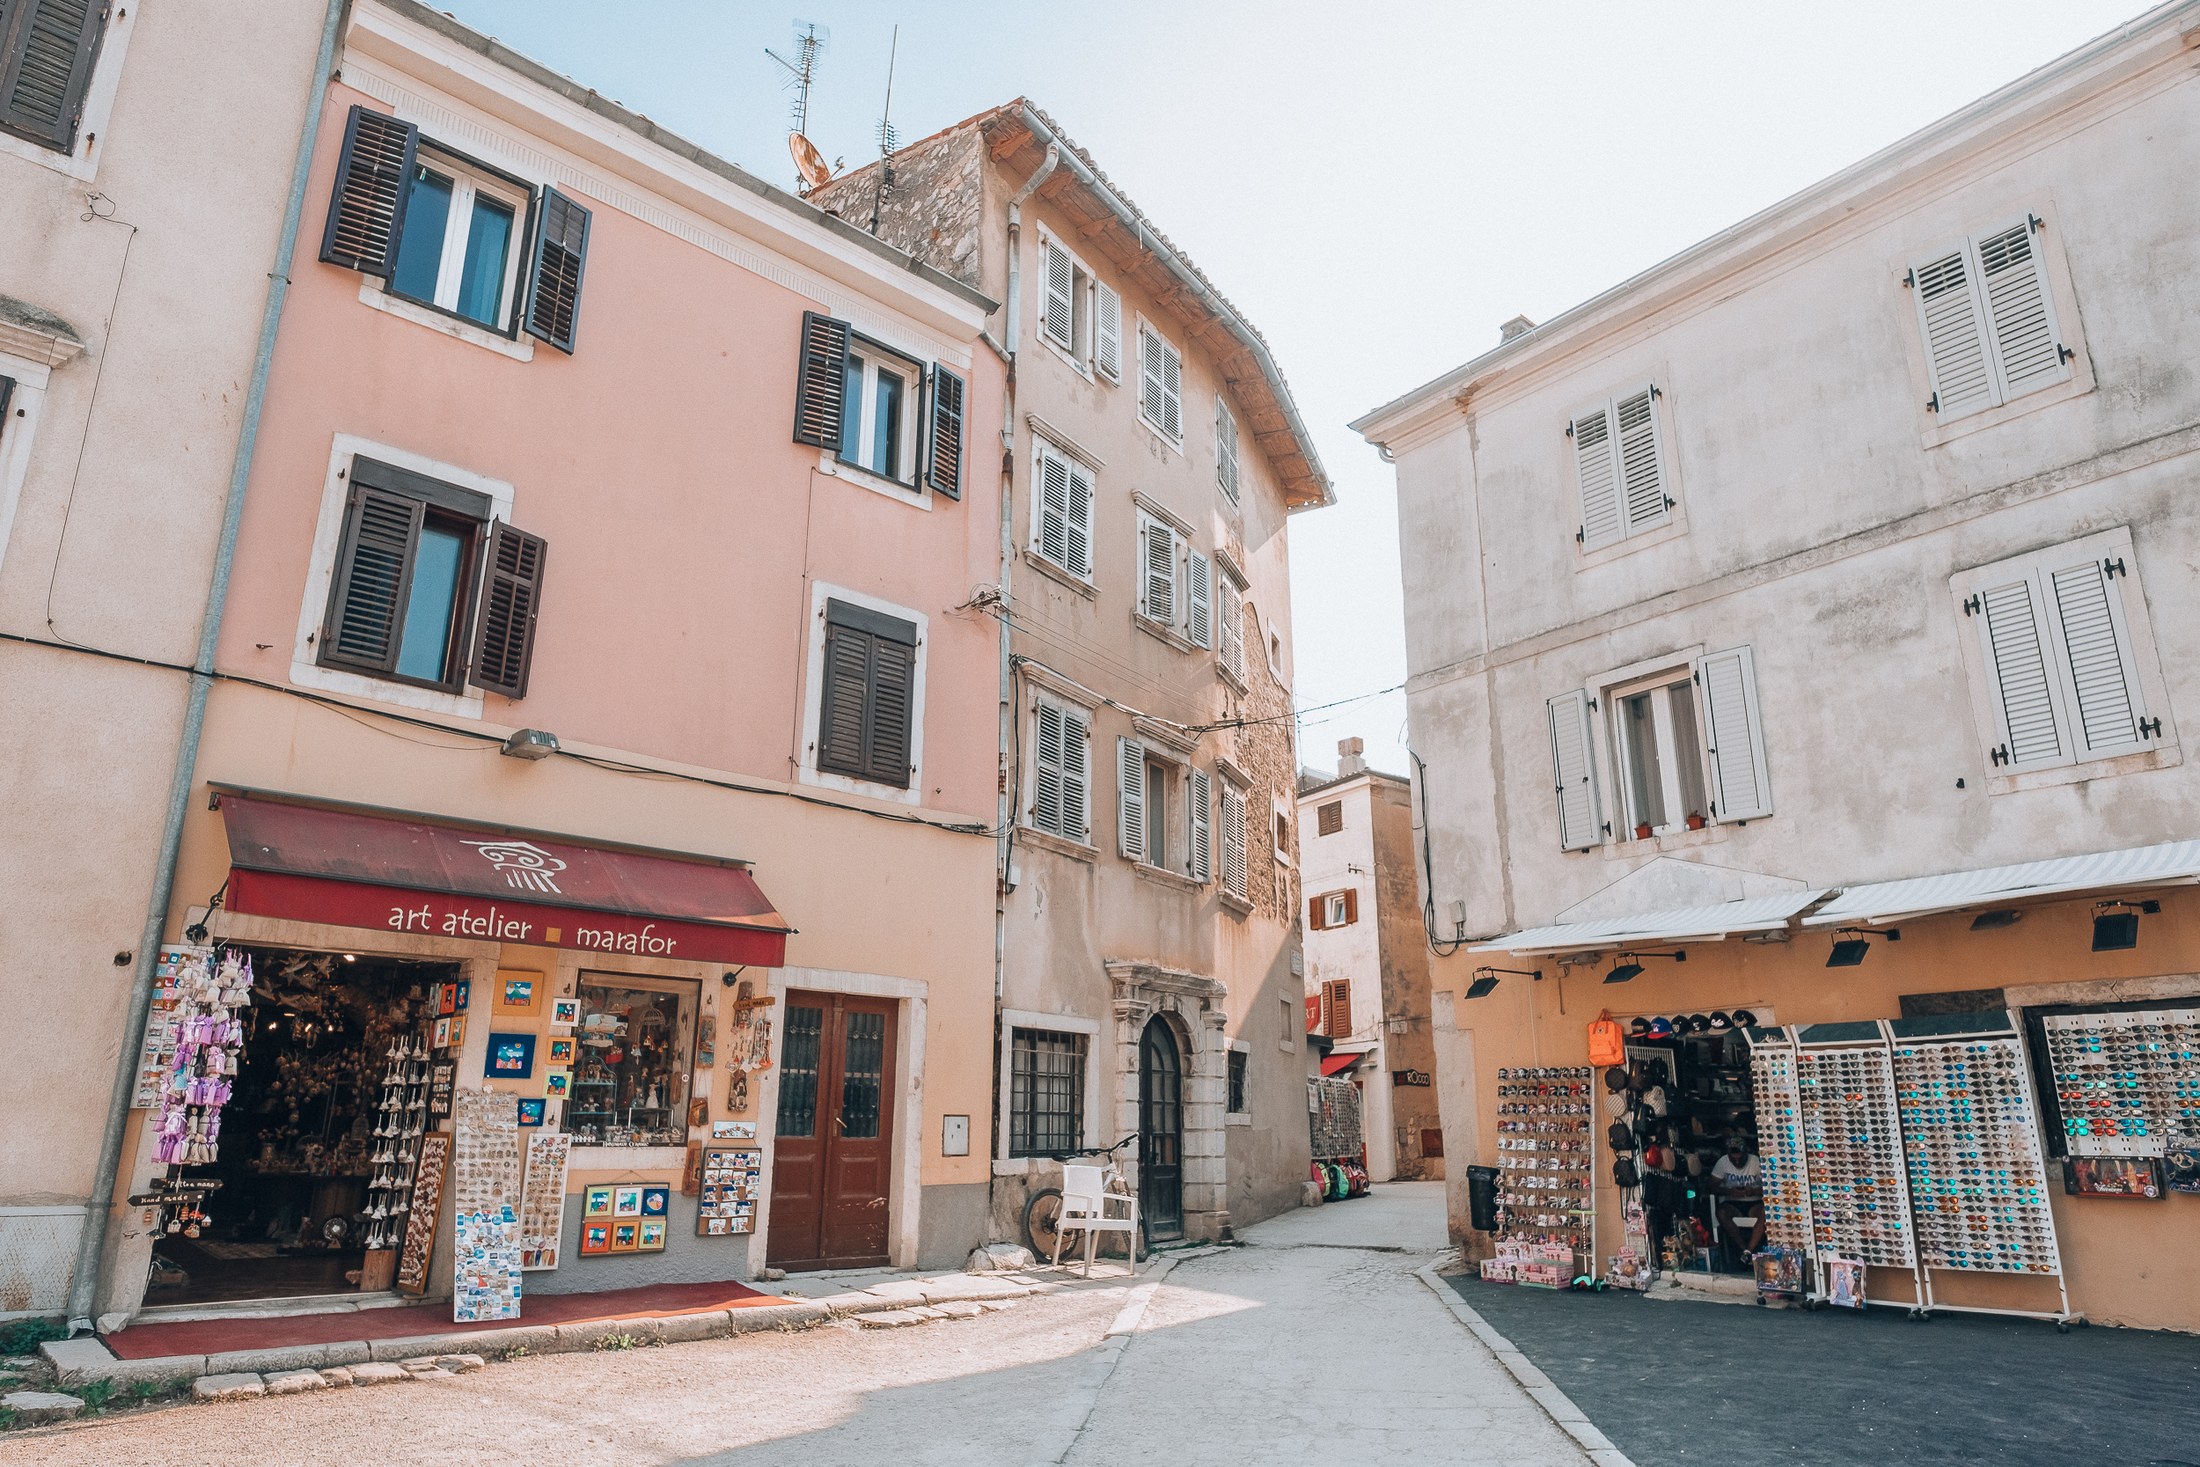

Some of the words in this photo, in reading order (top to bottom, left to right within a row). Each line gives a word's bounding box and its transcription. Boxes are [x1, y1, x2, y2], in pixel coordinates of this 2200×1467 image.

[387, 904, 432, 930] art
[442, 906, 532, 939] atelier
[576, 924, 677, 954] marafor
[1726, 1173, 1757, 1183] TOMMY
[163, 1194, 188, 1202] made
